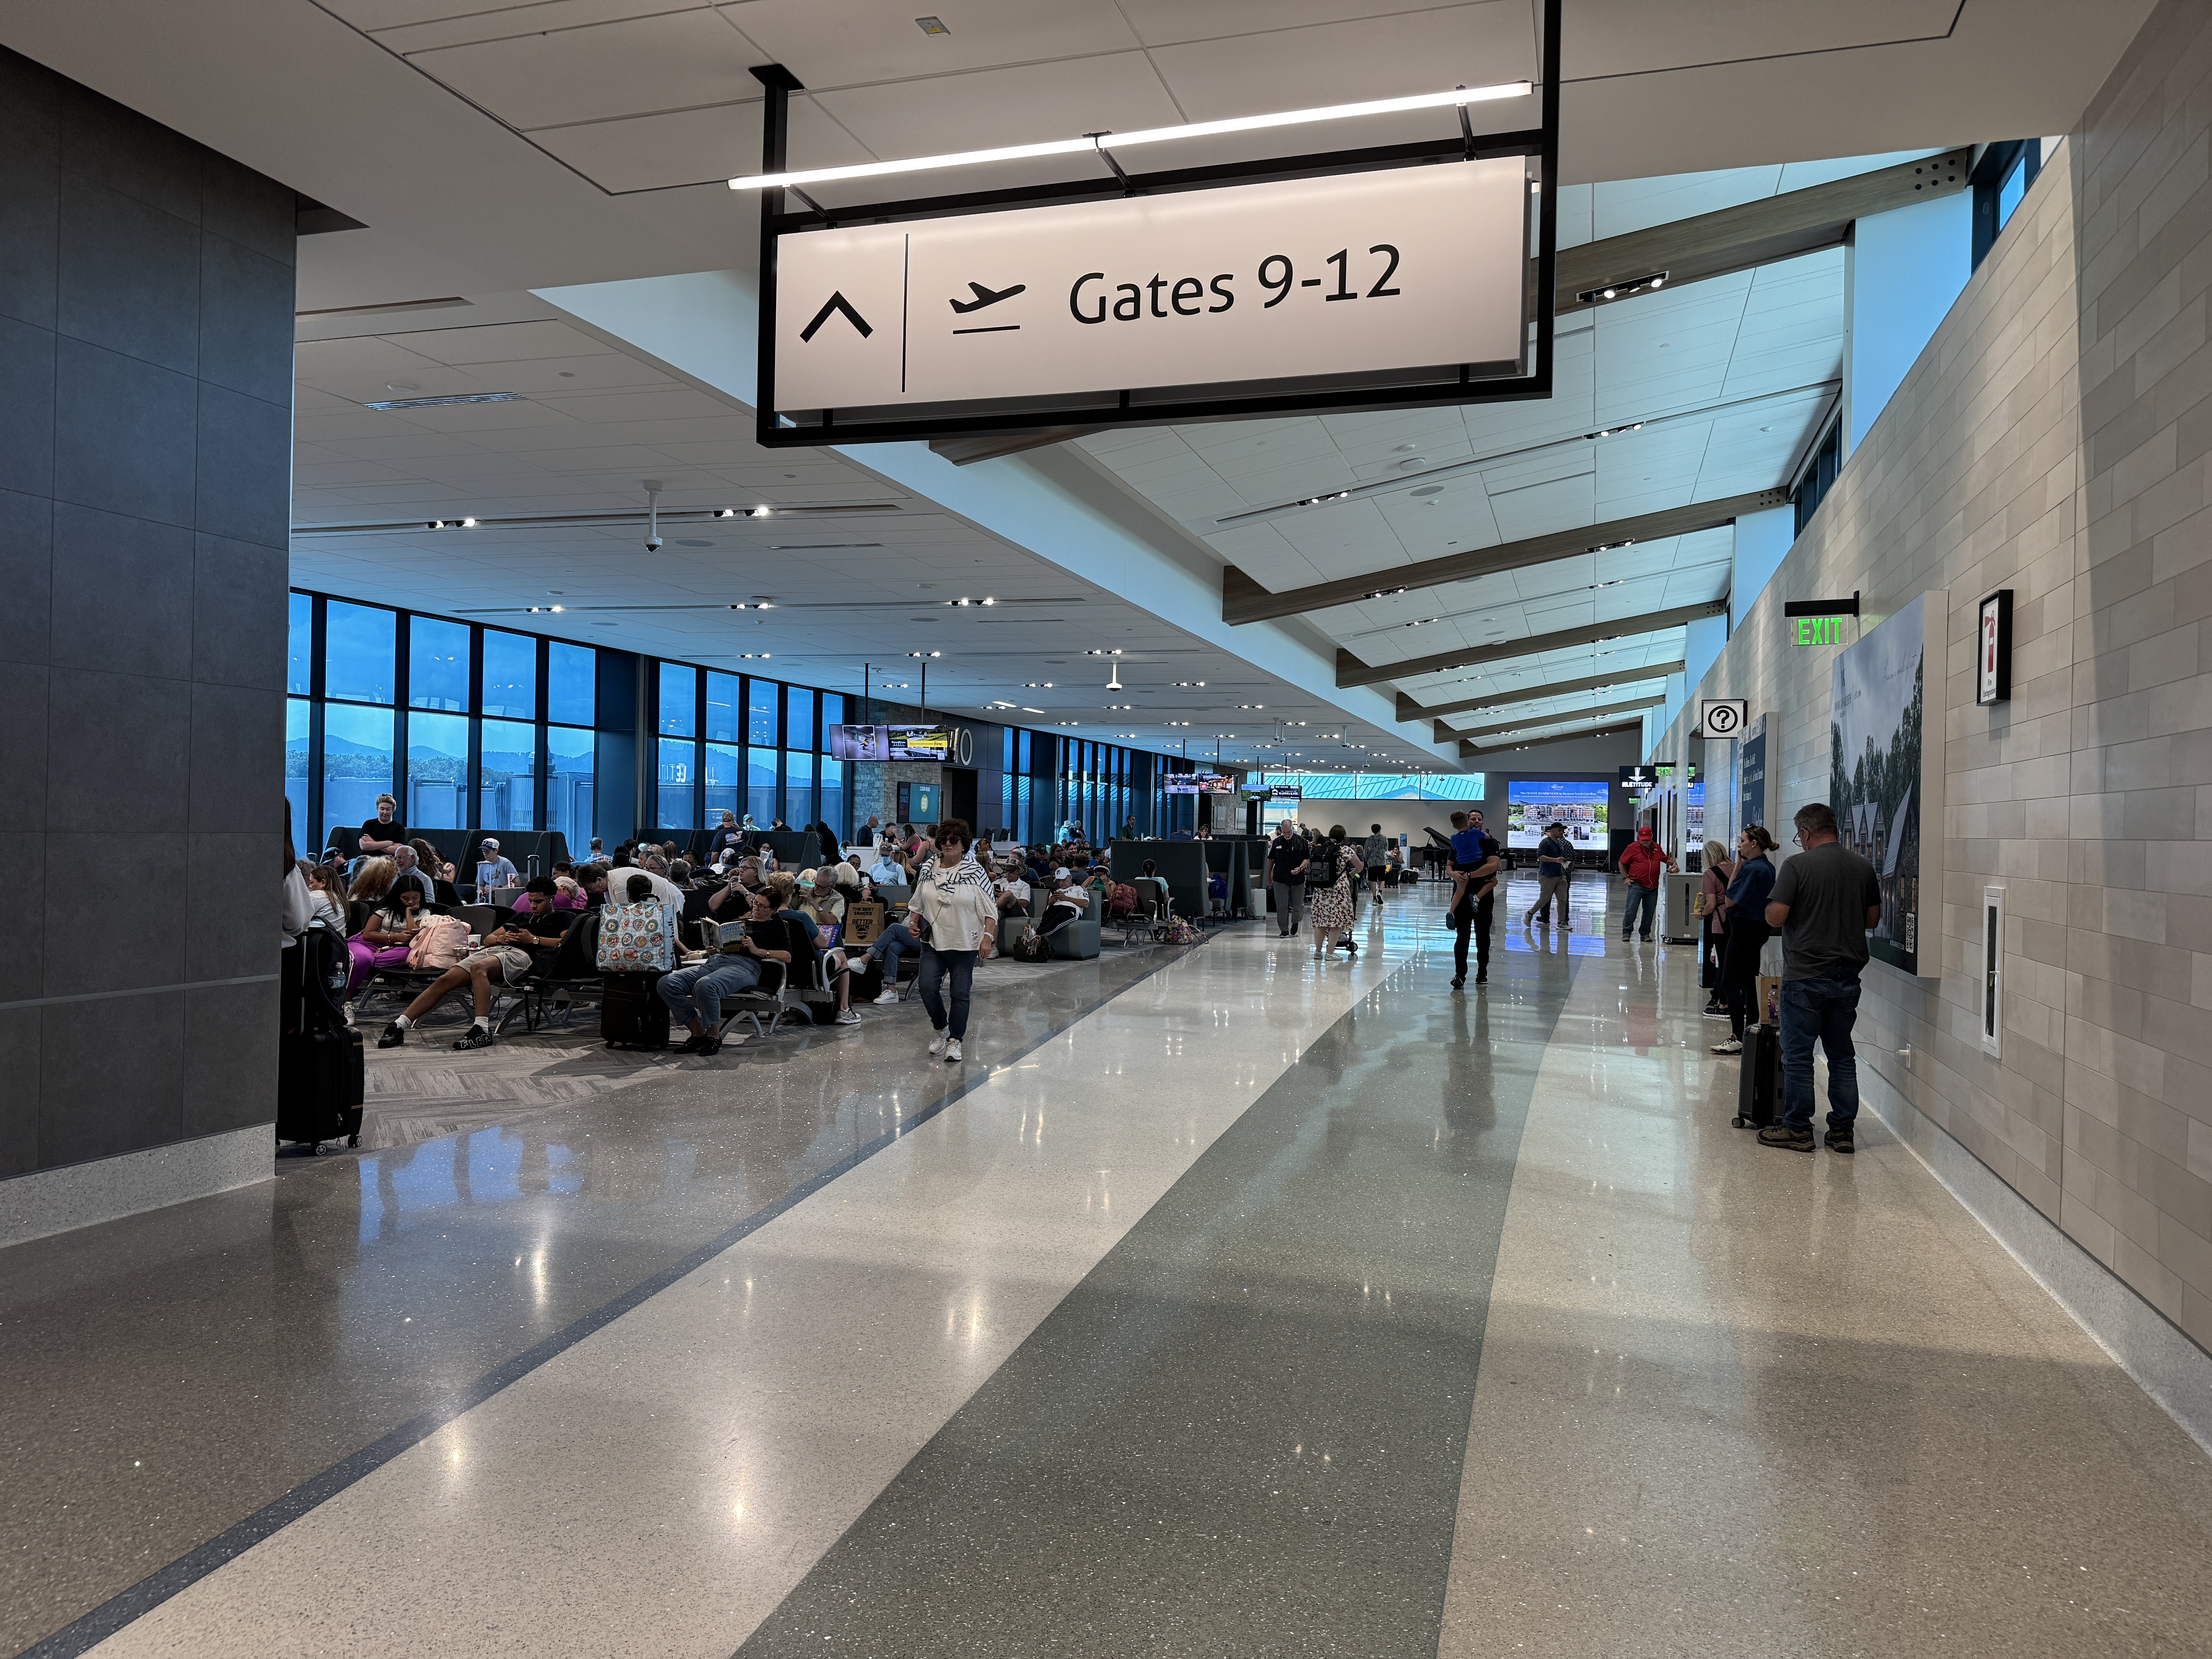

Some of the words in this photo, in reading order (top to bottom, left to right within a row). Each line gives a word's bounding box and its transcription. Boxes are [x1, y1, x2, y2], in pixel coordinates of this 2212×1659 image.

[1070, 273, 1234, 325] Gates
[1258, 244, 1400, 309] 9-12
[1798, 617, 1843, 645] EXIT
